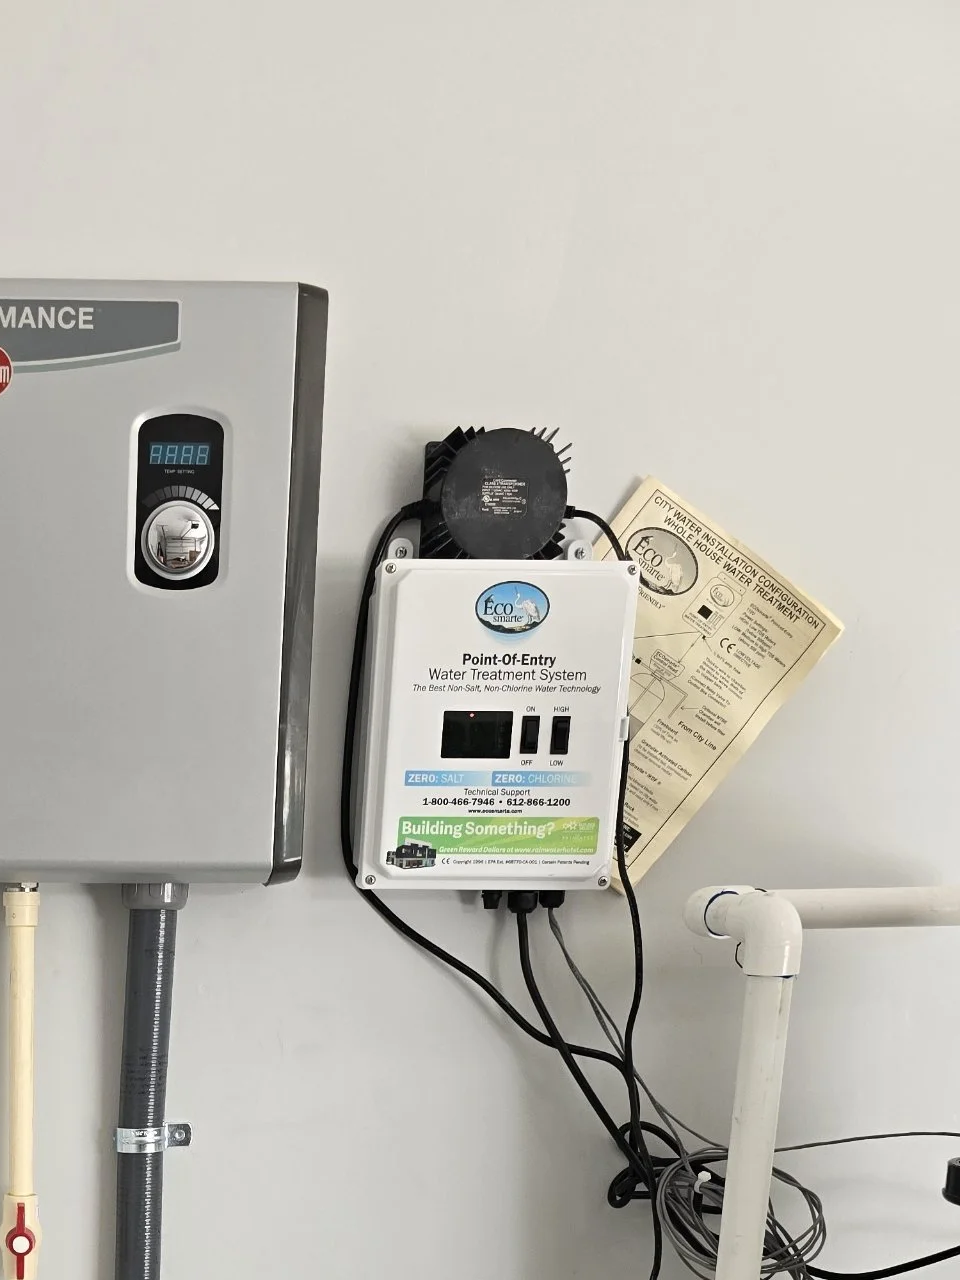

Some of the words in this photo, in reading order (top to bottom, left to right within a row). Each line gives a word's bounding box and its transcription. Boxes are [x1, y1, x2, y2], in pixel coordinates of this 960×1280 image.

[654, 496, 674, 513] CITY
[673, 509, 702, 536] WATER
[701, 531, 762, 578] INSTALLATION
[758, 575, 820, 629] CONFIGURATION
[663, 515, 693, 542] WHOLE
[693, 540, 724, 565] HOUSE
[722, 562, 752, 587] WATER
[752, 583, 801, 623] TREATMENT
[462, 654, 556, 668] Point-Of-Entry
[429, 668, 466, 681] Water
[470, 668, 536, 681] Treatment
[540, 668, 587, 683] System
[447, 684, 481, 693] Non-Salt,
[559, 685, 601, 694] Technology
[678, 720, 693, 734] From
[692, 731, 705, 743] City
[704, 739, 718, 751] Line
[408, 774, 439, 783] ZERO:
[441, 774, 464, 783] SALT
[494, 774, 526, 783] ZERO:
[528, 774, 577, 783] CHLORINE
[501, 788, 530, 796] Support
[422, 798, 494, 806] 1-800-466-7946
[402, 821, 462, 838] Building
[465, 821, 555, 839] Something?
